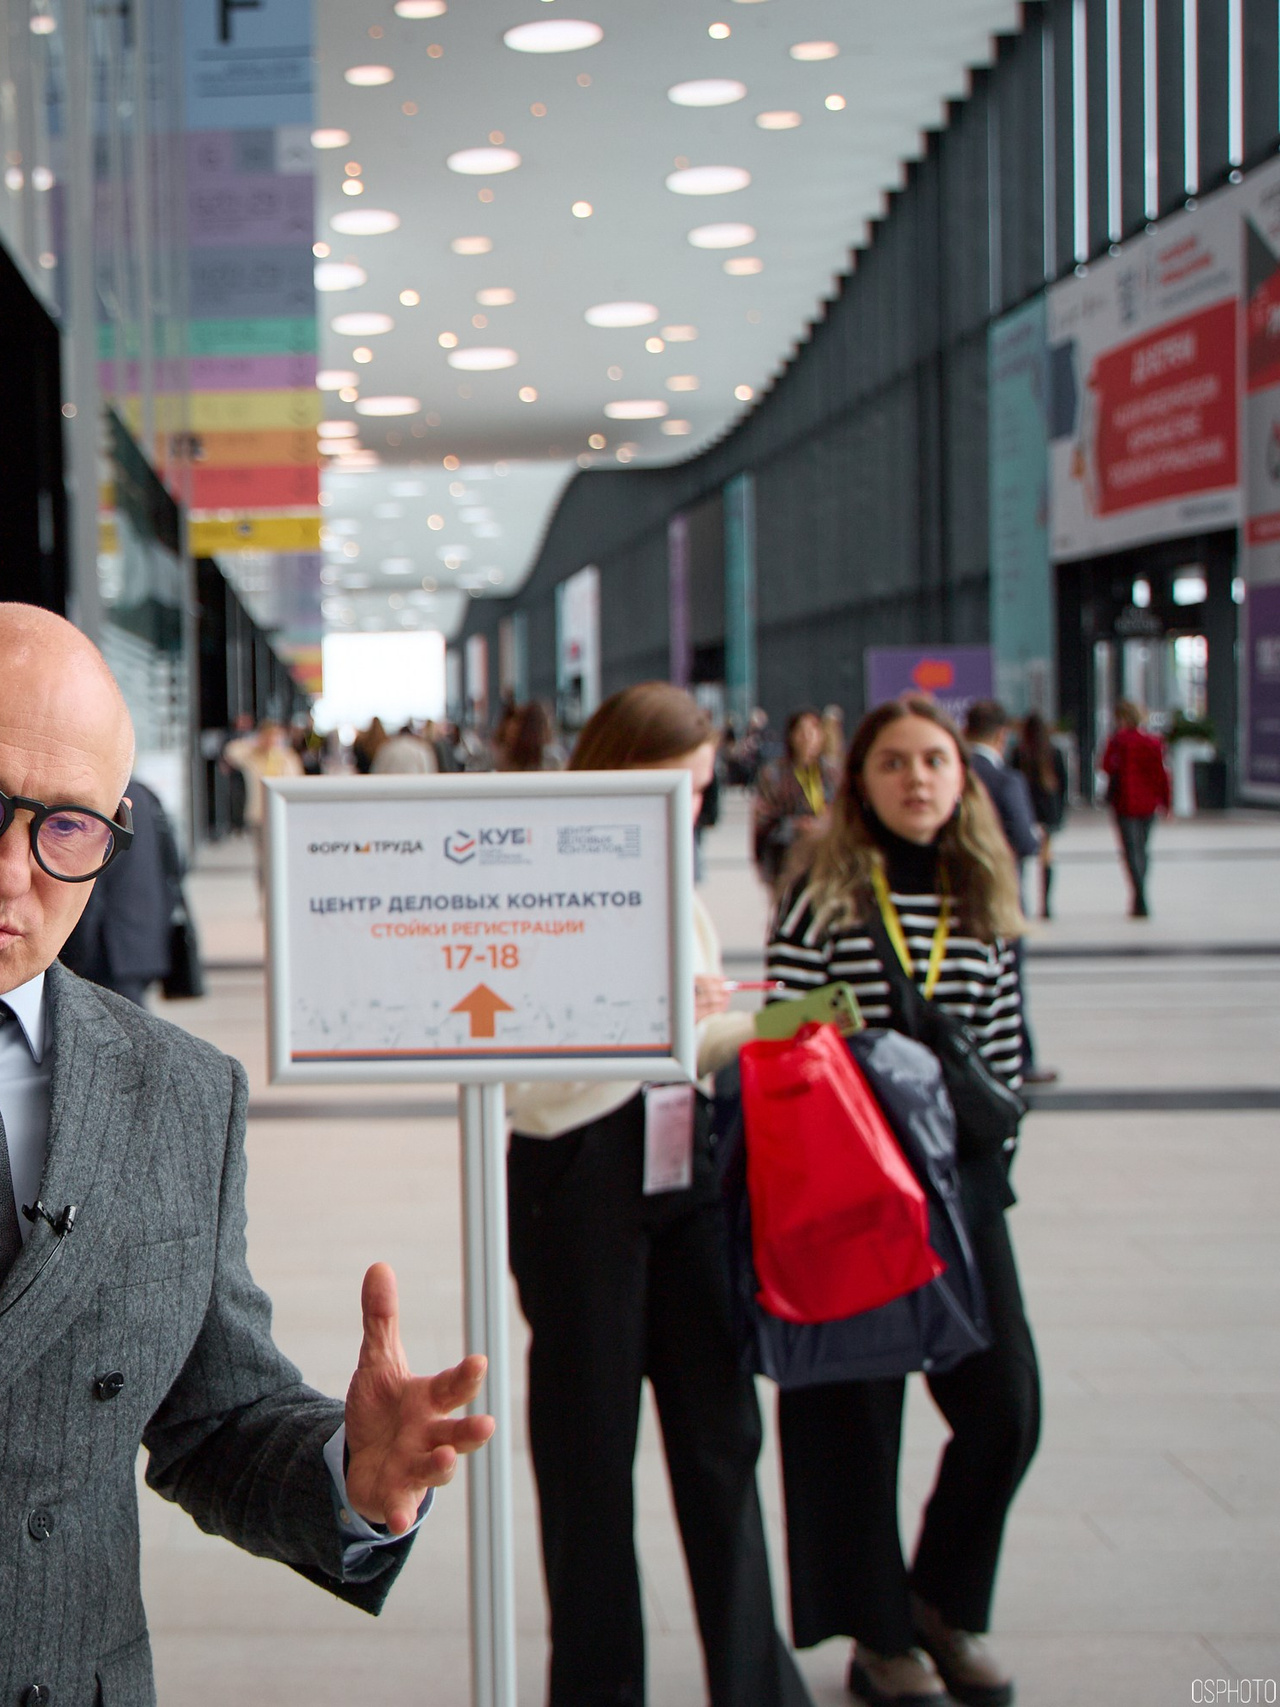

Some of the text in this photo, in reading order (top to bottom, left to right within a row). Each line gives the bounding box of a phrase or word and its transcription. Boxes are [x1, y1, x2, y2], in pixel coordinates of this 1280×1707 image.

[479, 827, 526, 845] КУБ
[310, 891, 642, 914] ЦЕНТР ДЕЛОВЫХ КОНТАКТОВ
[370, 919, 585, 938] СТОЙКИ РЕГИСТРАЦИИ
[440, 943, 520, 970] 17-18
